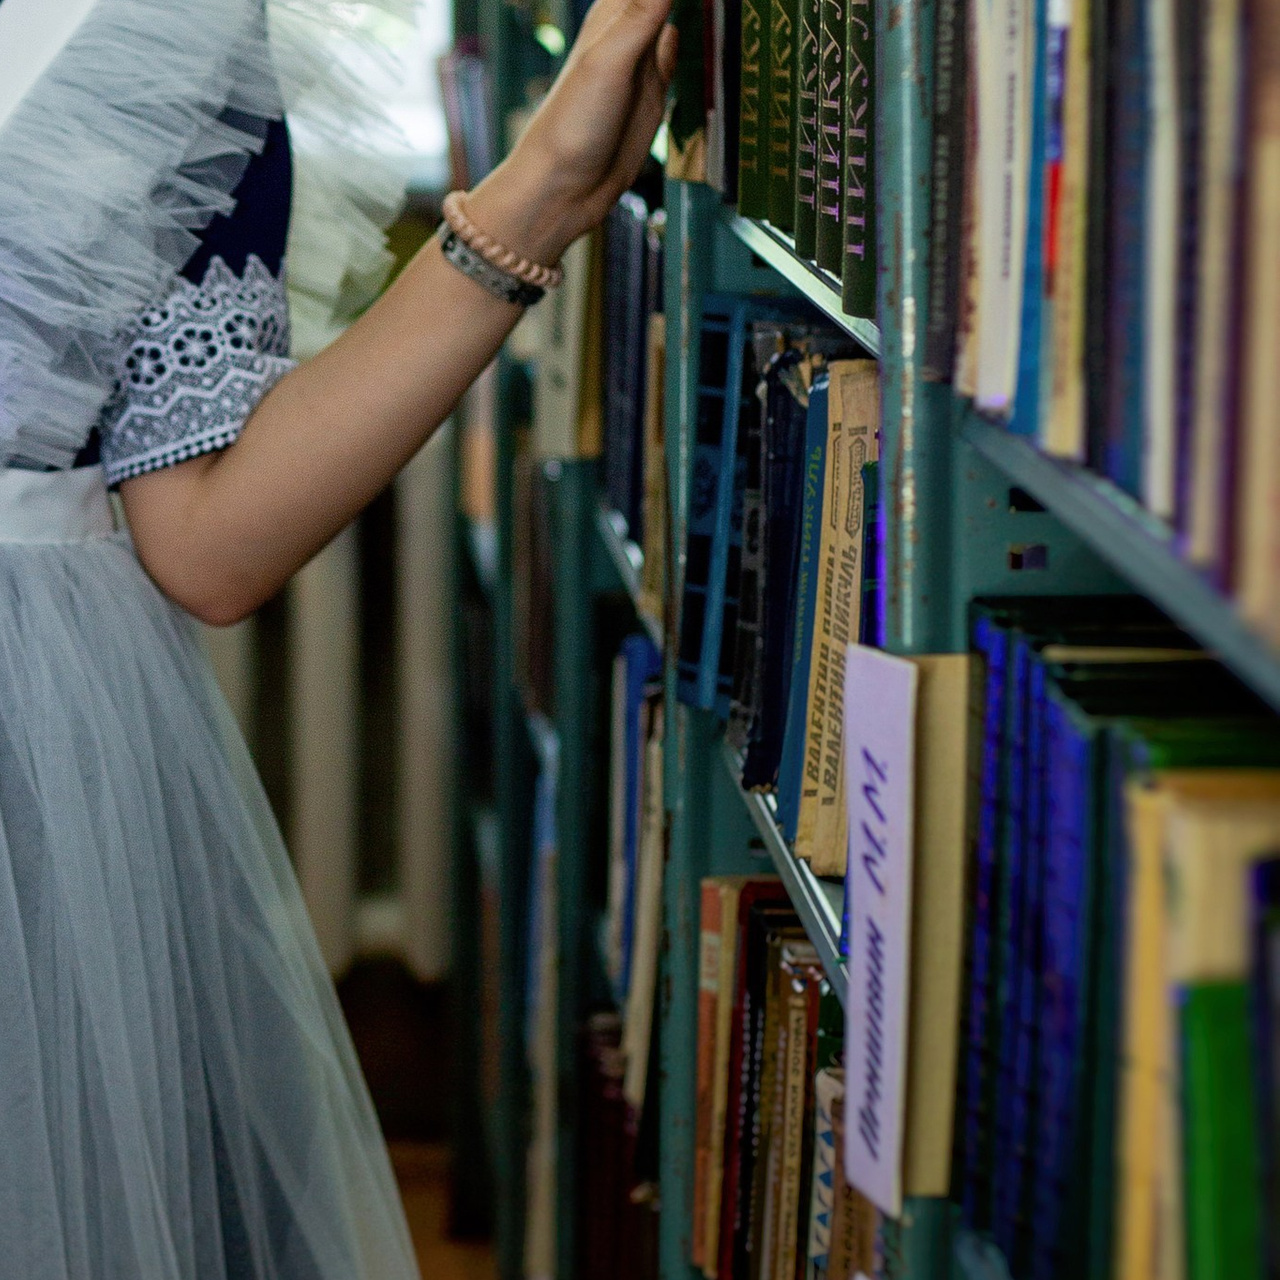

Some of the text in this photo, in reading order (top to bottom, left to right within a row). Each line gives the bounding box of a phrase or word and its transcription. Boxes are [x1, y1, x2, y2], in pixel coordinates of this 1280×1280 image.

[801, 446, 822, 562] ПИКУЛЬ
[833, 545, 858, 645] ПИКУЛЬ
[822, 649, 847, 794] ВАЛЕНТИН
